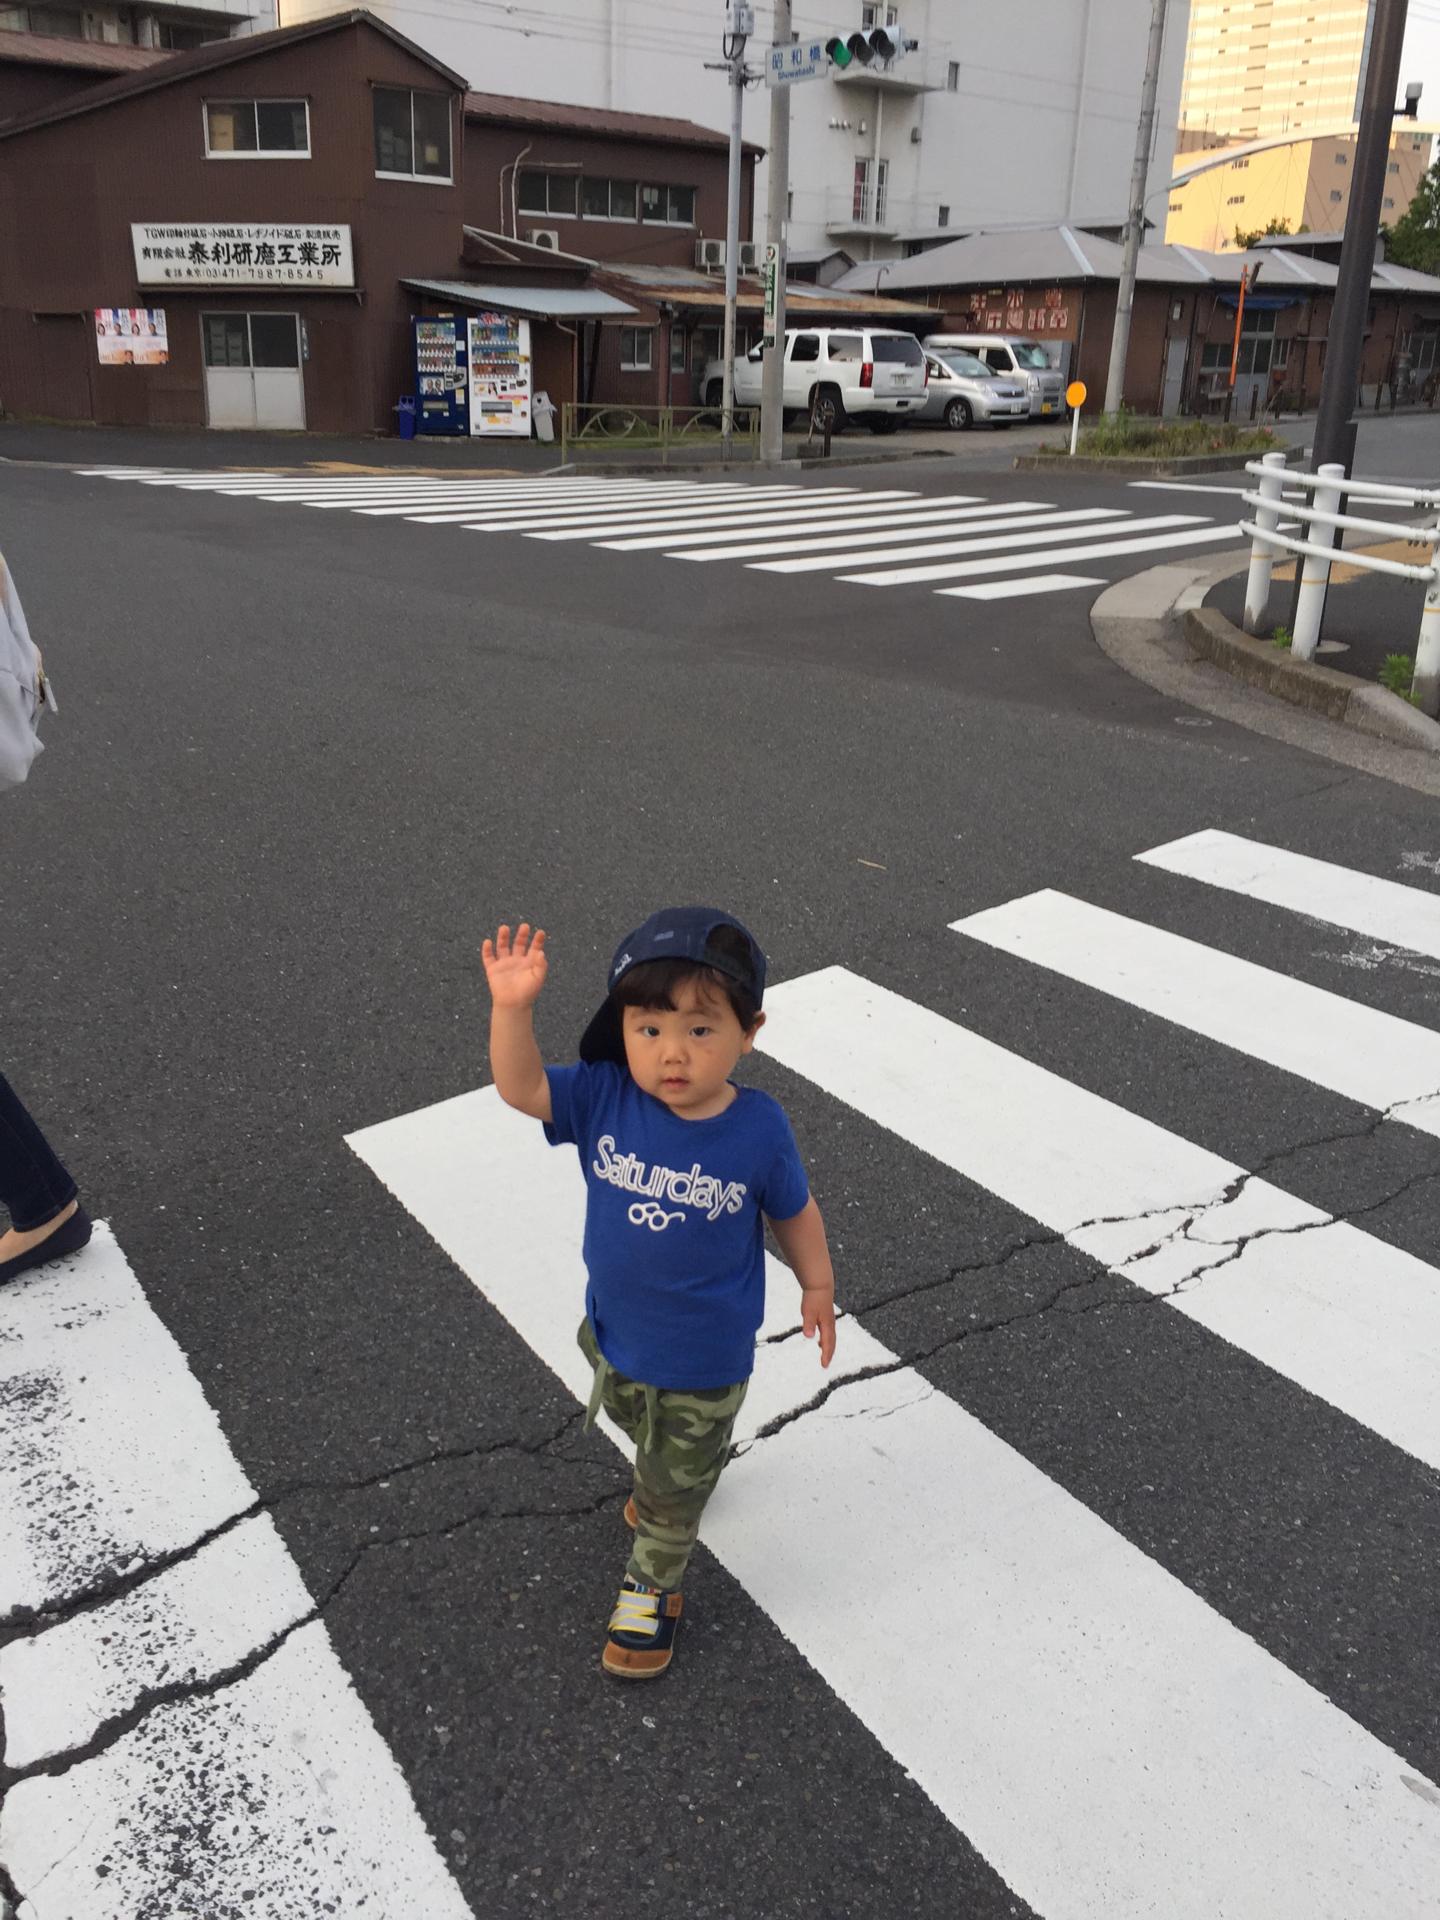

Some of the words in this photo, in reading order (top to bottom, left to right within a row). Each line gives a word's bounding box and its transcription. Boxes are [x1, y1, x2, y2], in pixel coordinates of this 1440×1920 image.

[772, 45, 821, 70] 昭和橋
[593, 1134, 747, 1221] Saturdays
